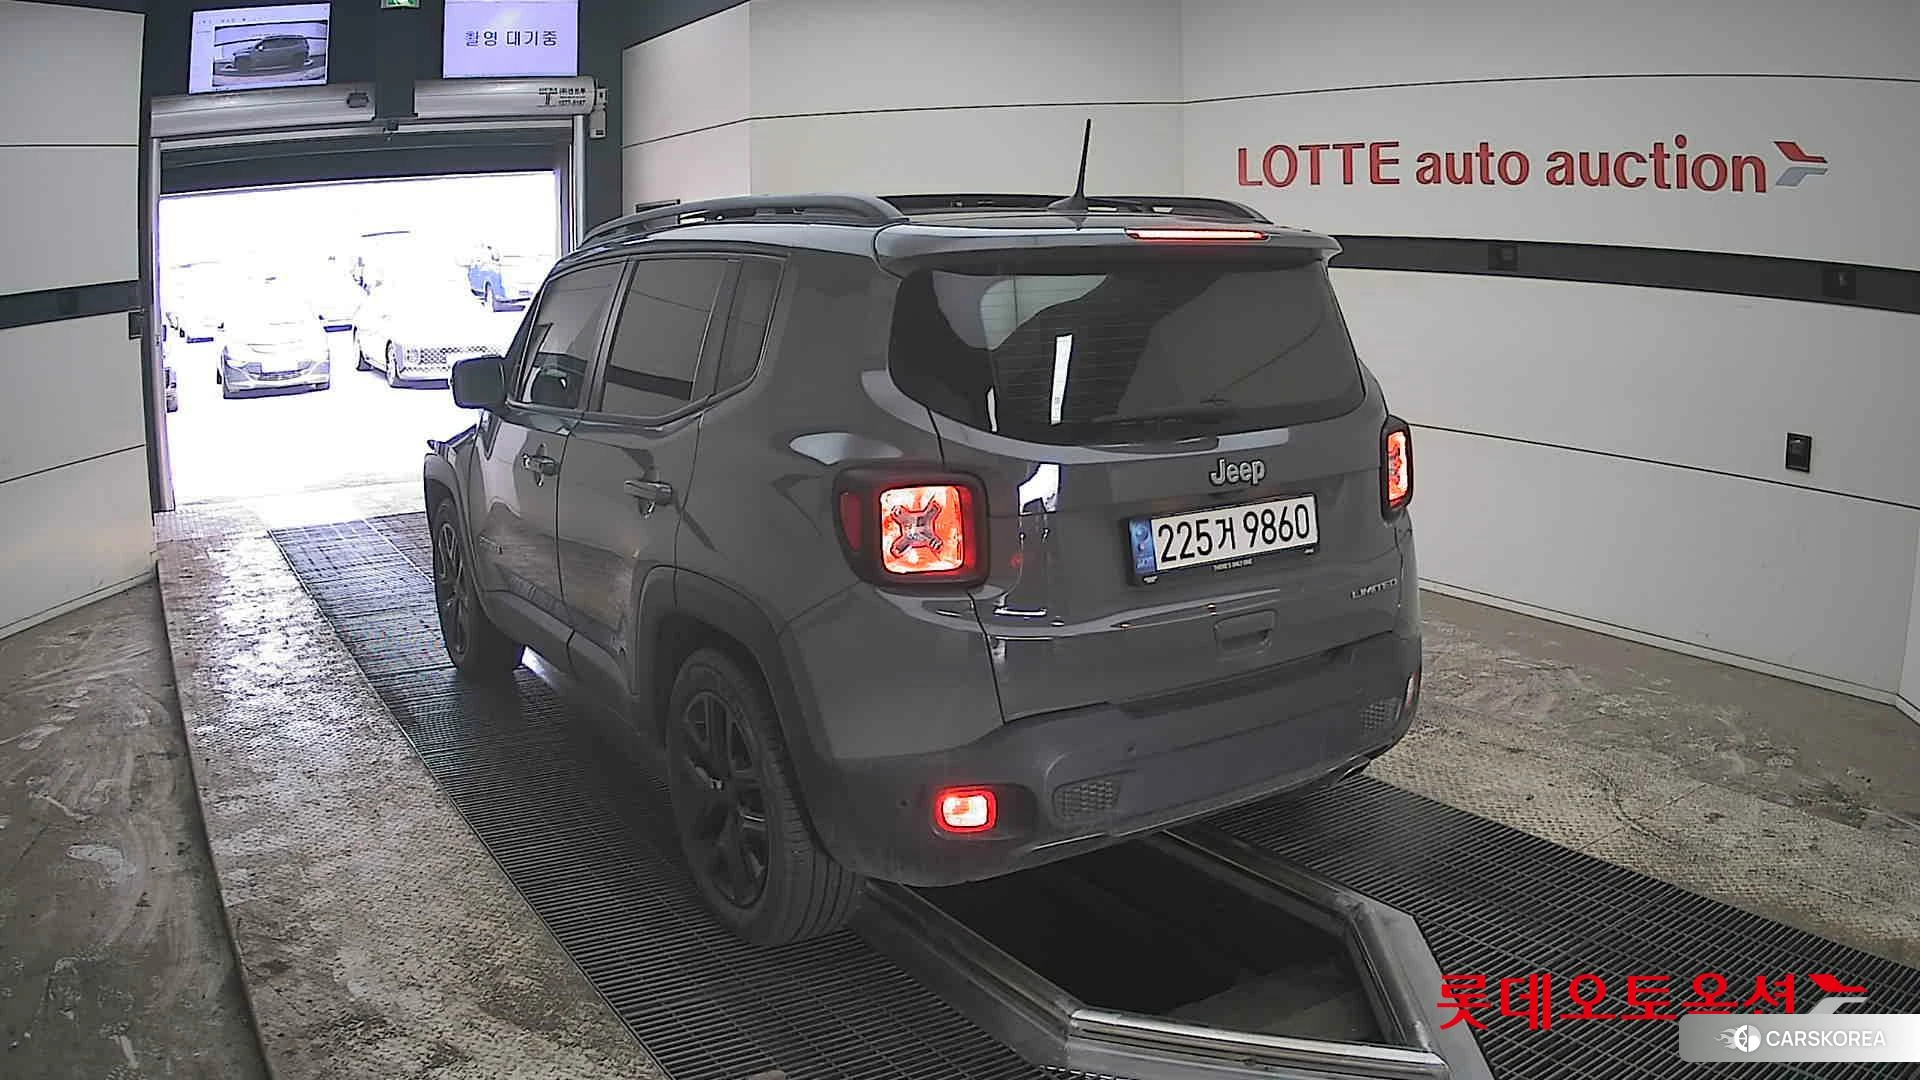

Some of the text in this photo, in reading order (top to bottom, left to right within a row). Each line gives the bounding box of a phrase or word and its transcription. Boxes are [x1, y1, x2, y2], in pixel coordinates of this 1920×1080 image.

[506, 30, 557, 48] 대기중
[1237, 134, 1767, 194] LOTTE auto auction
[1209, 458, 1266, 486] Jeep
[1158, 503, 1310, 563] 225거 9860
